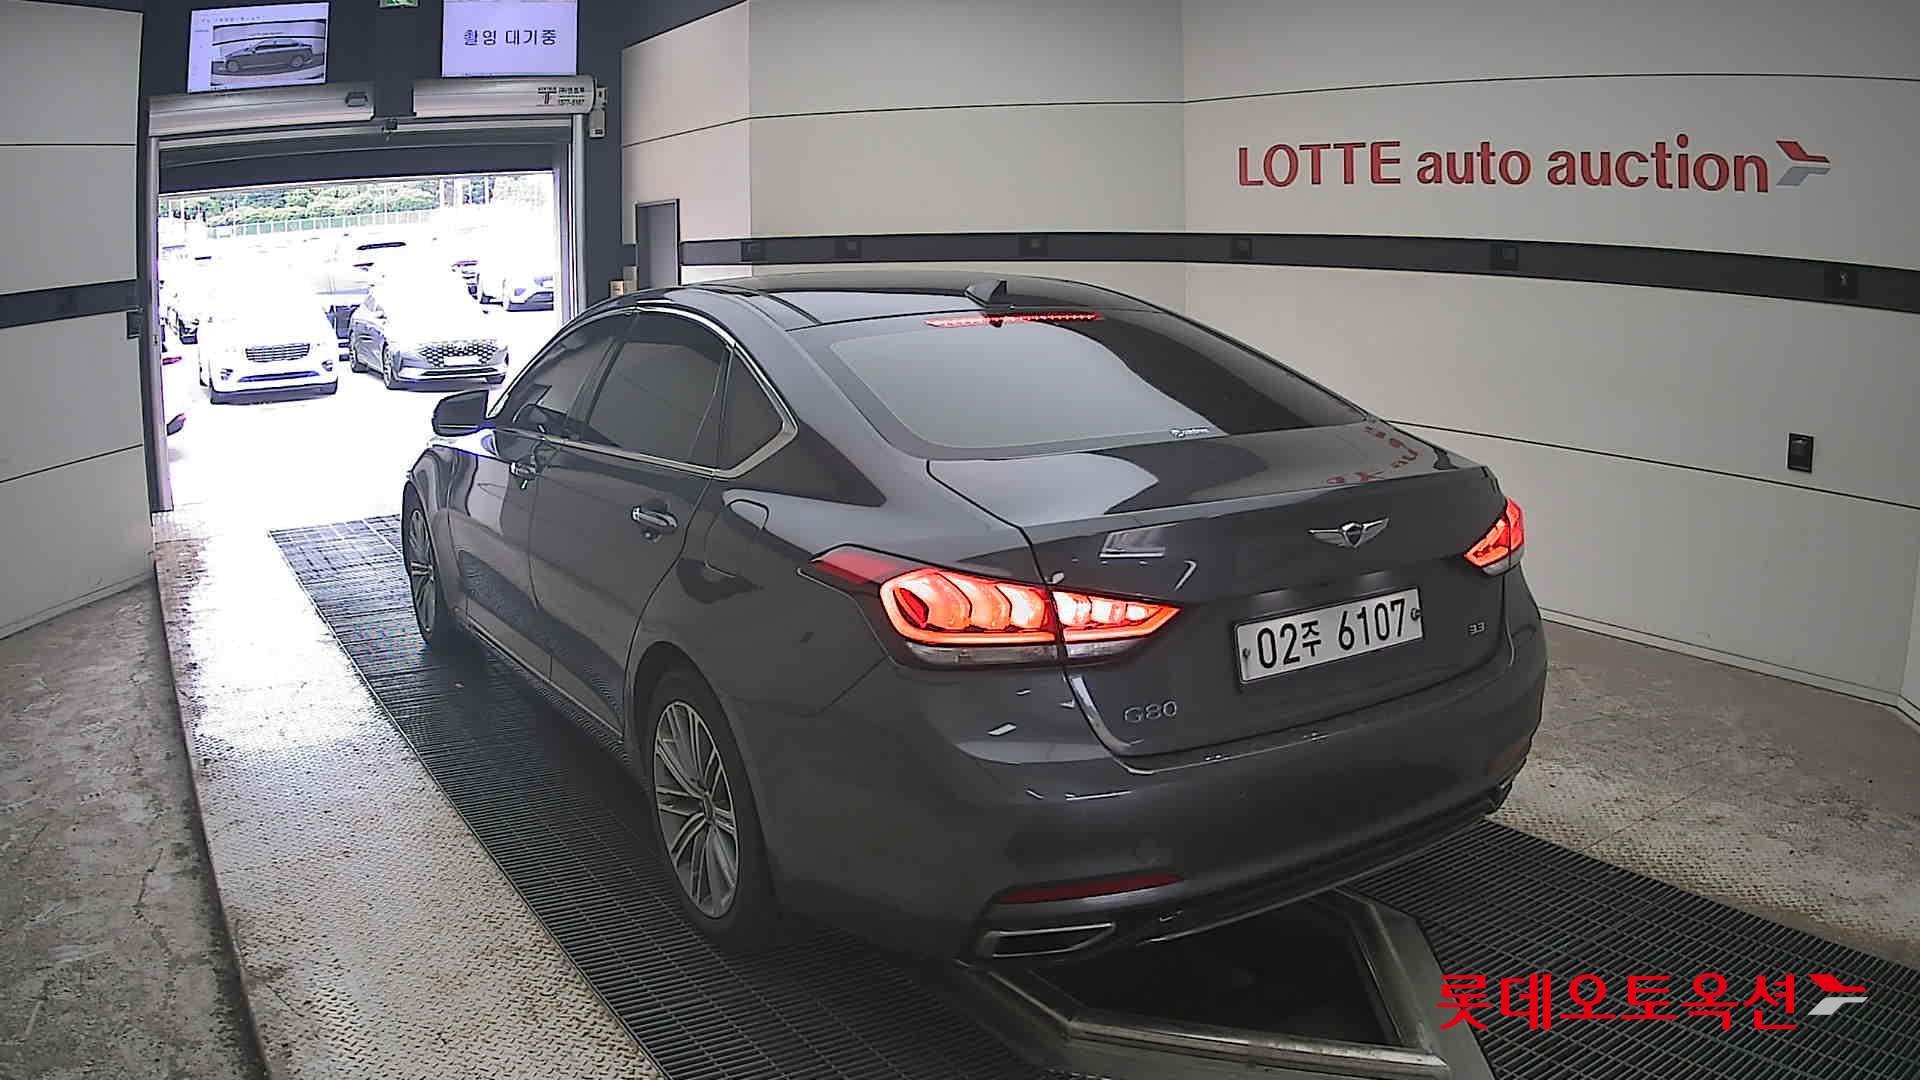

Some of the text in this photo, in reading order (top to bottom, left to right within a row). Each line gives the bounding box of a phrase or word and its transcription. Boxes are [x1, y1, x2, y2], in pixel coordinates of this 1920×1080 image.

[1238, 134, 1769, 193] LOTTE auto auction
[1255, 598, 1406, 670] 02주 6107
[1124, 700, 1177, 724] G80
